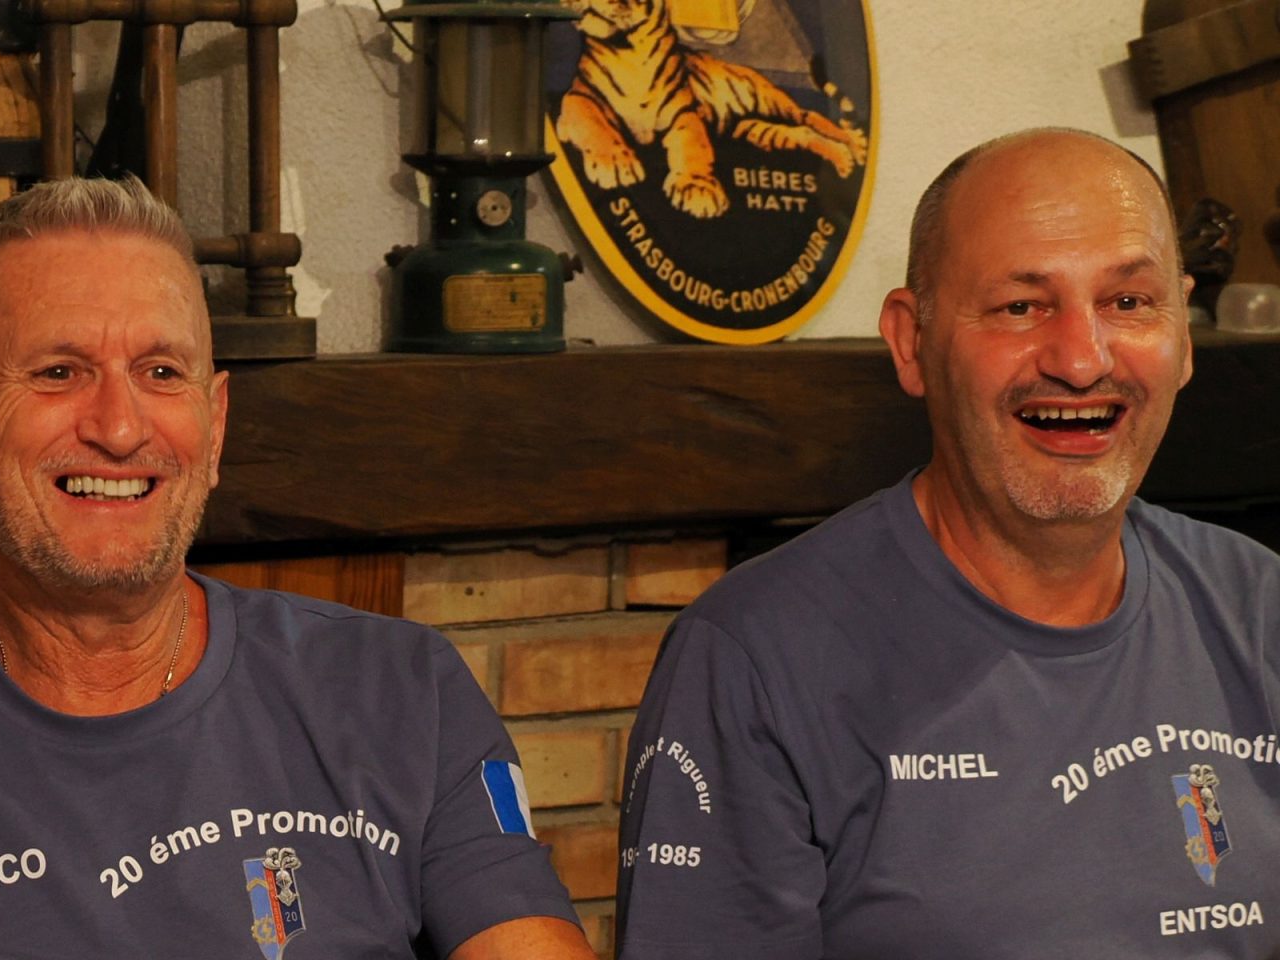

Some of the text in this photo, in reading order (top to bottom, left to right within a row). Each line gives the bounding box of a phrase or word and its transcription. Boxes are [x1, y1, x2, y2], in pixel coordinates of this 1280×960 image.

[746, 193, 808, 213] HATT
[667, 741, 711, 814] Rigueur
[889, 754, 999, 781] MICHEL
[1051, 723, 1280, 804] 20 éme Promoti
[100, 807, 401, 899] 20 éme Promotion
[647, 843, 701, 867] 1985
[284, 911, 298, 922] 20
[1159, 901, 1264, 936] ENTSOA
